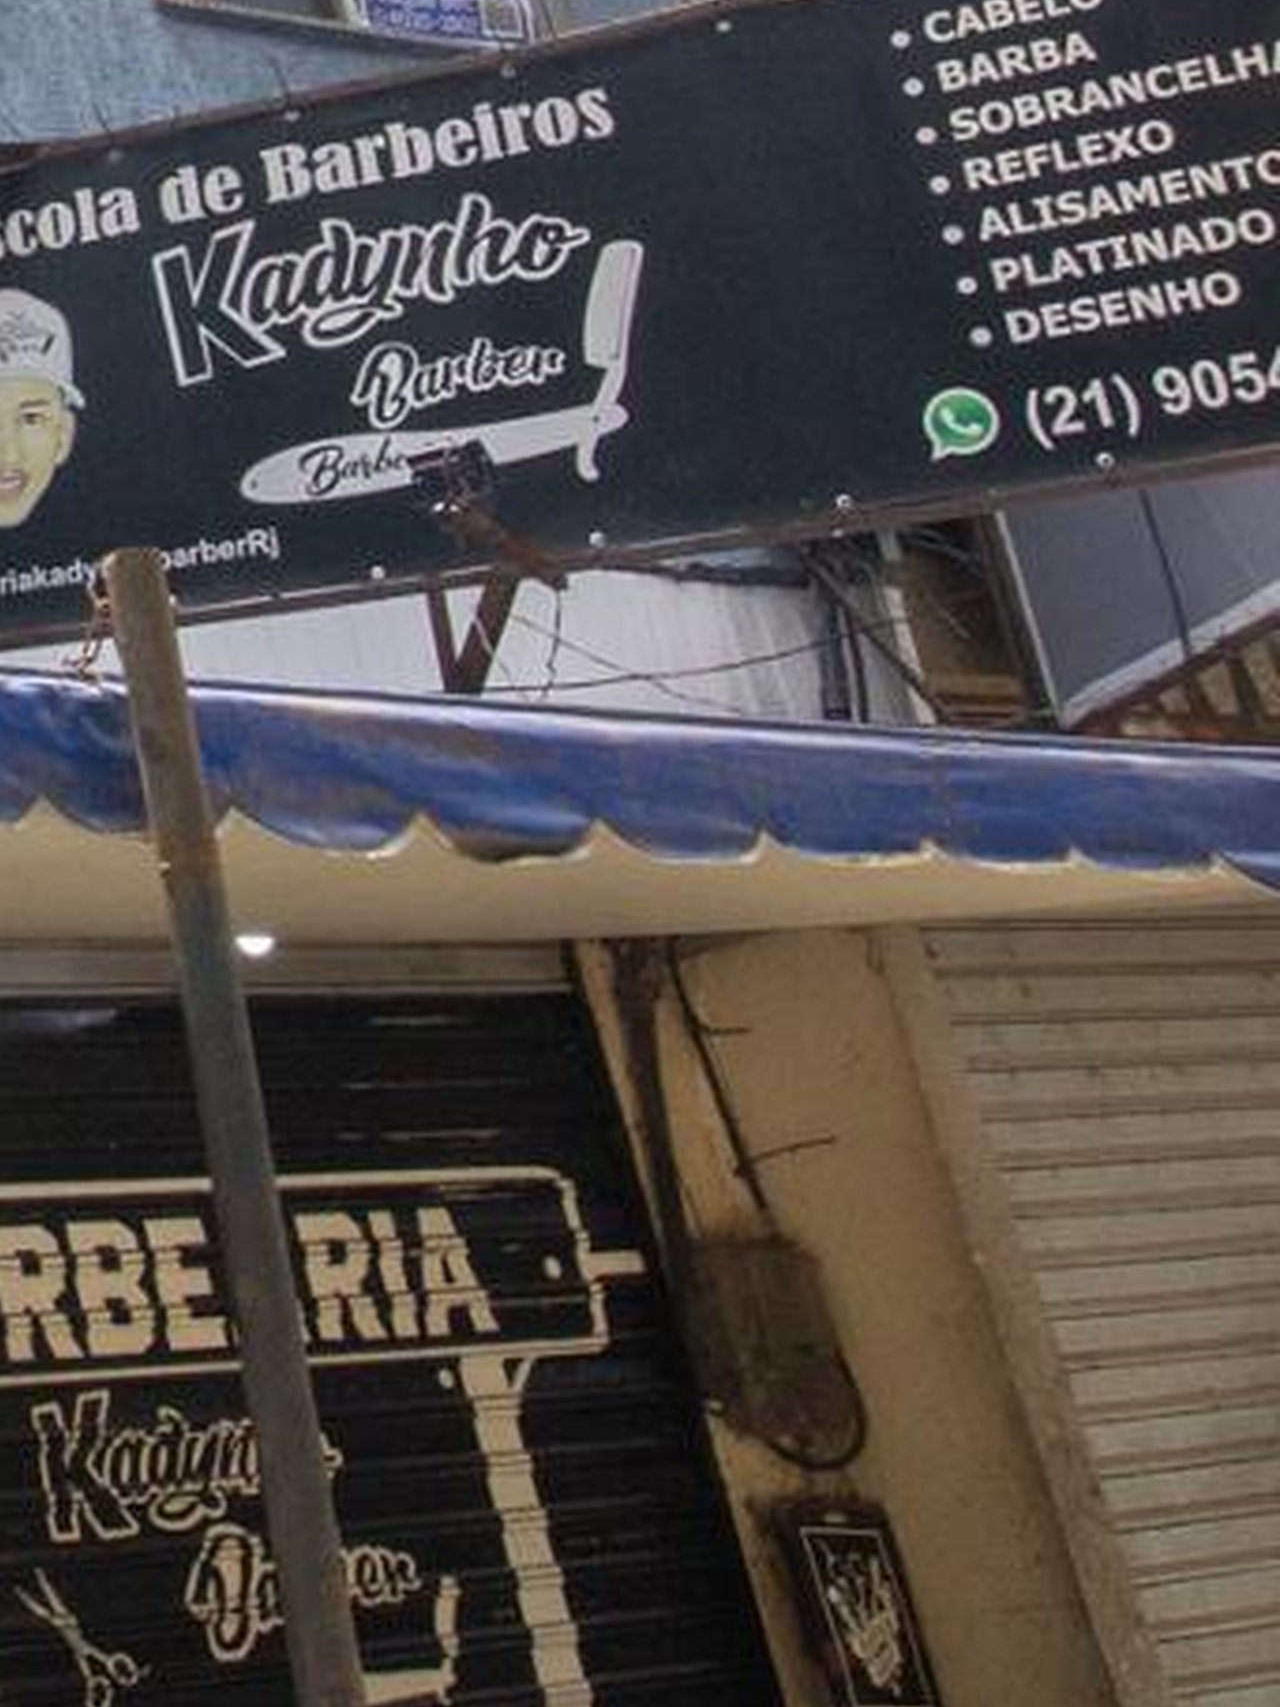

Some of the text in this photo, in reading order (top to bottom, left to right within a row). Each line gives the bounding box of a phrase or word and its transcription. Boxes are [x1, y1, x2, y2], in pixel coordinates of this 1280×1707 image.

[936, 33, 1098, 92] BARBA
[949, 40, 1280, 141] SOBRANCELH
[160, 165, 242, 226] de
[260, 88, 614, 205] Barbeiros
[963, 120, 1175, 190] REFLEXO
[153, 193, 590, 387] Kadynho
[990, 209, 1276, 291] PLATINADO
[1005, 272, 1241, 344] DESENHO
[350, 338, 567, 428] Barber
[1027, 374, 1140, 450] (21)
